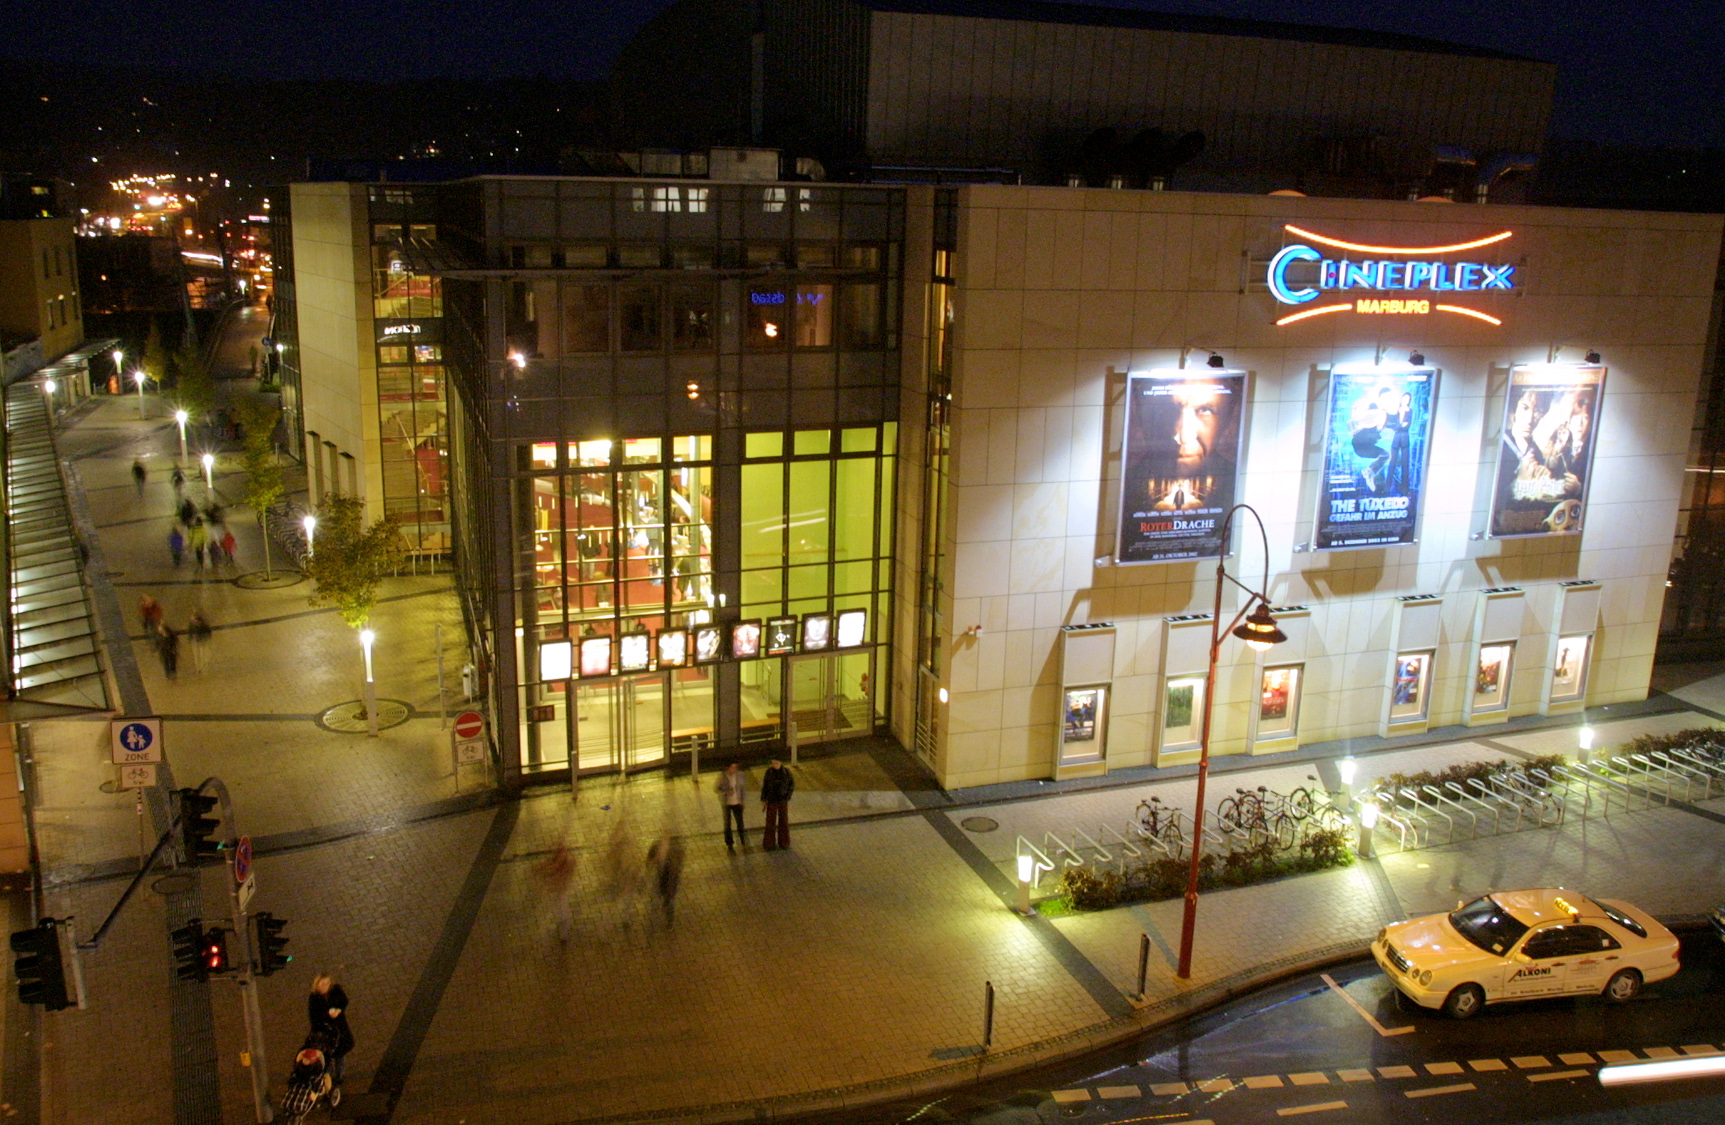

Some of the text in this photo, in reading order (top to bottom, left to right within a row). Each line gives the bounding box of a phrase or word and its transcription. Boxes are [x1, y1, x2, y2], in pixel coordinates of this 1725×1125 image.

[1267, 244, 1516, 305] CINEPLEX
[1357, 299, 1430, 314] MARBURG
[1330, 497, 1409, 513] THE TUXEDO
[1329, 513, 1362, 522] GEFAHR
[1377, 510, 1408, 520] ANZUG
[125, 753, 149, 761] ZONE
